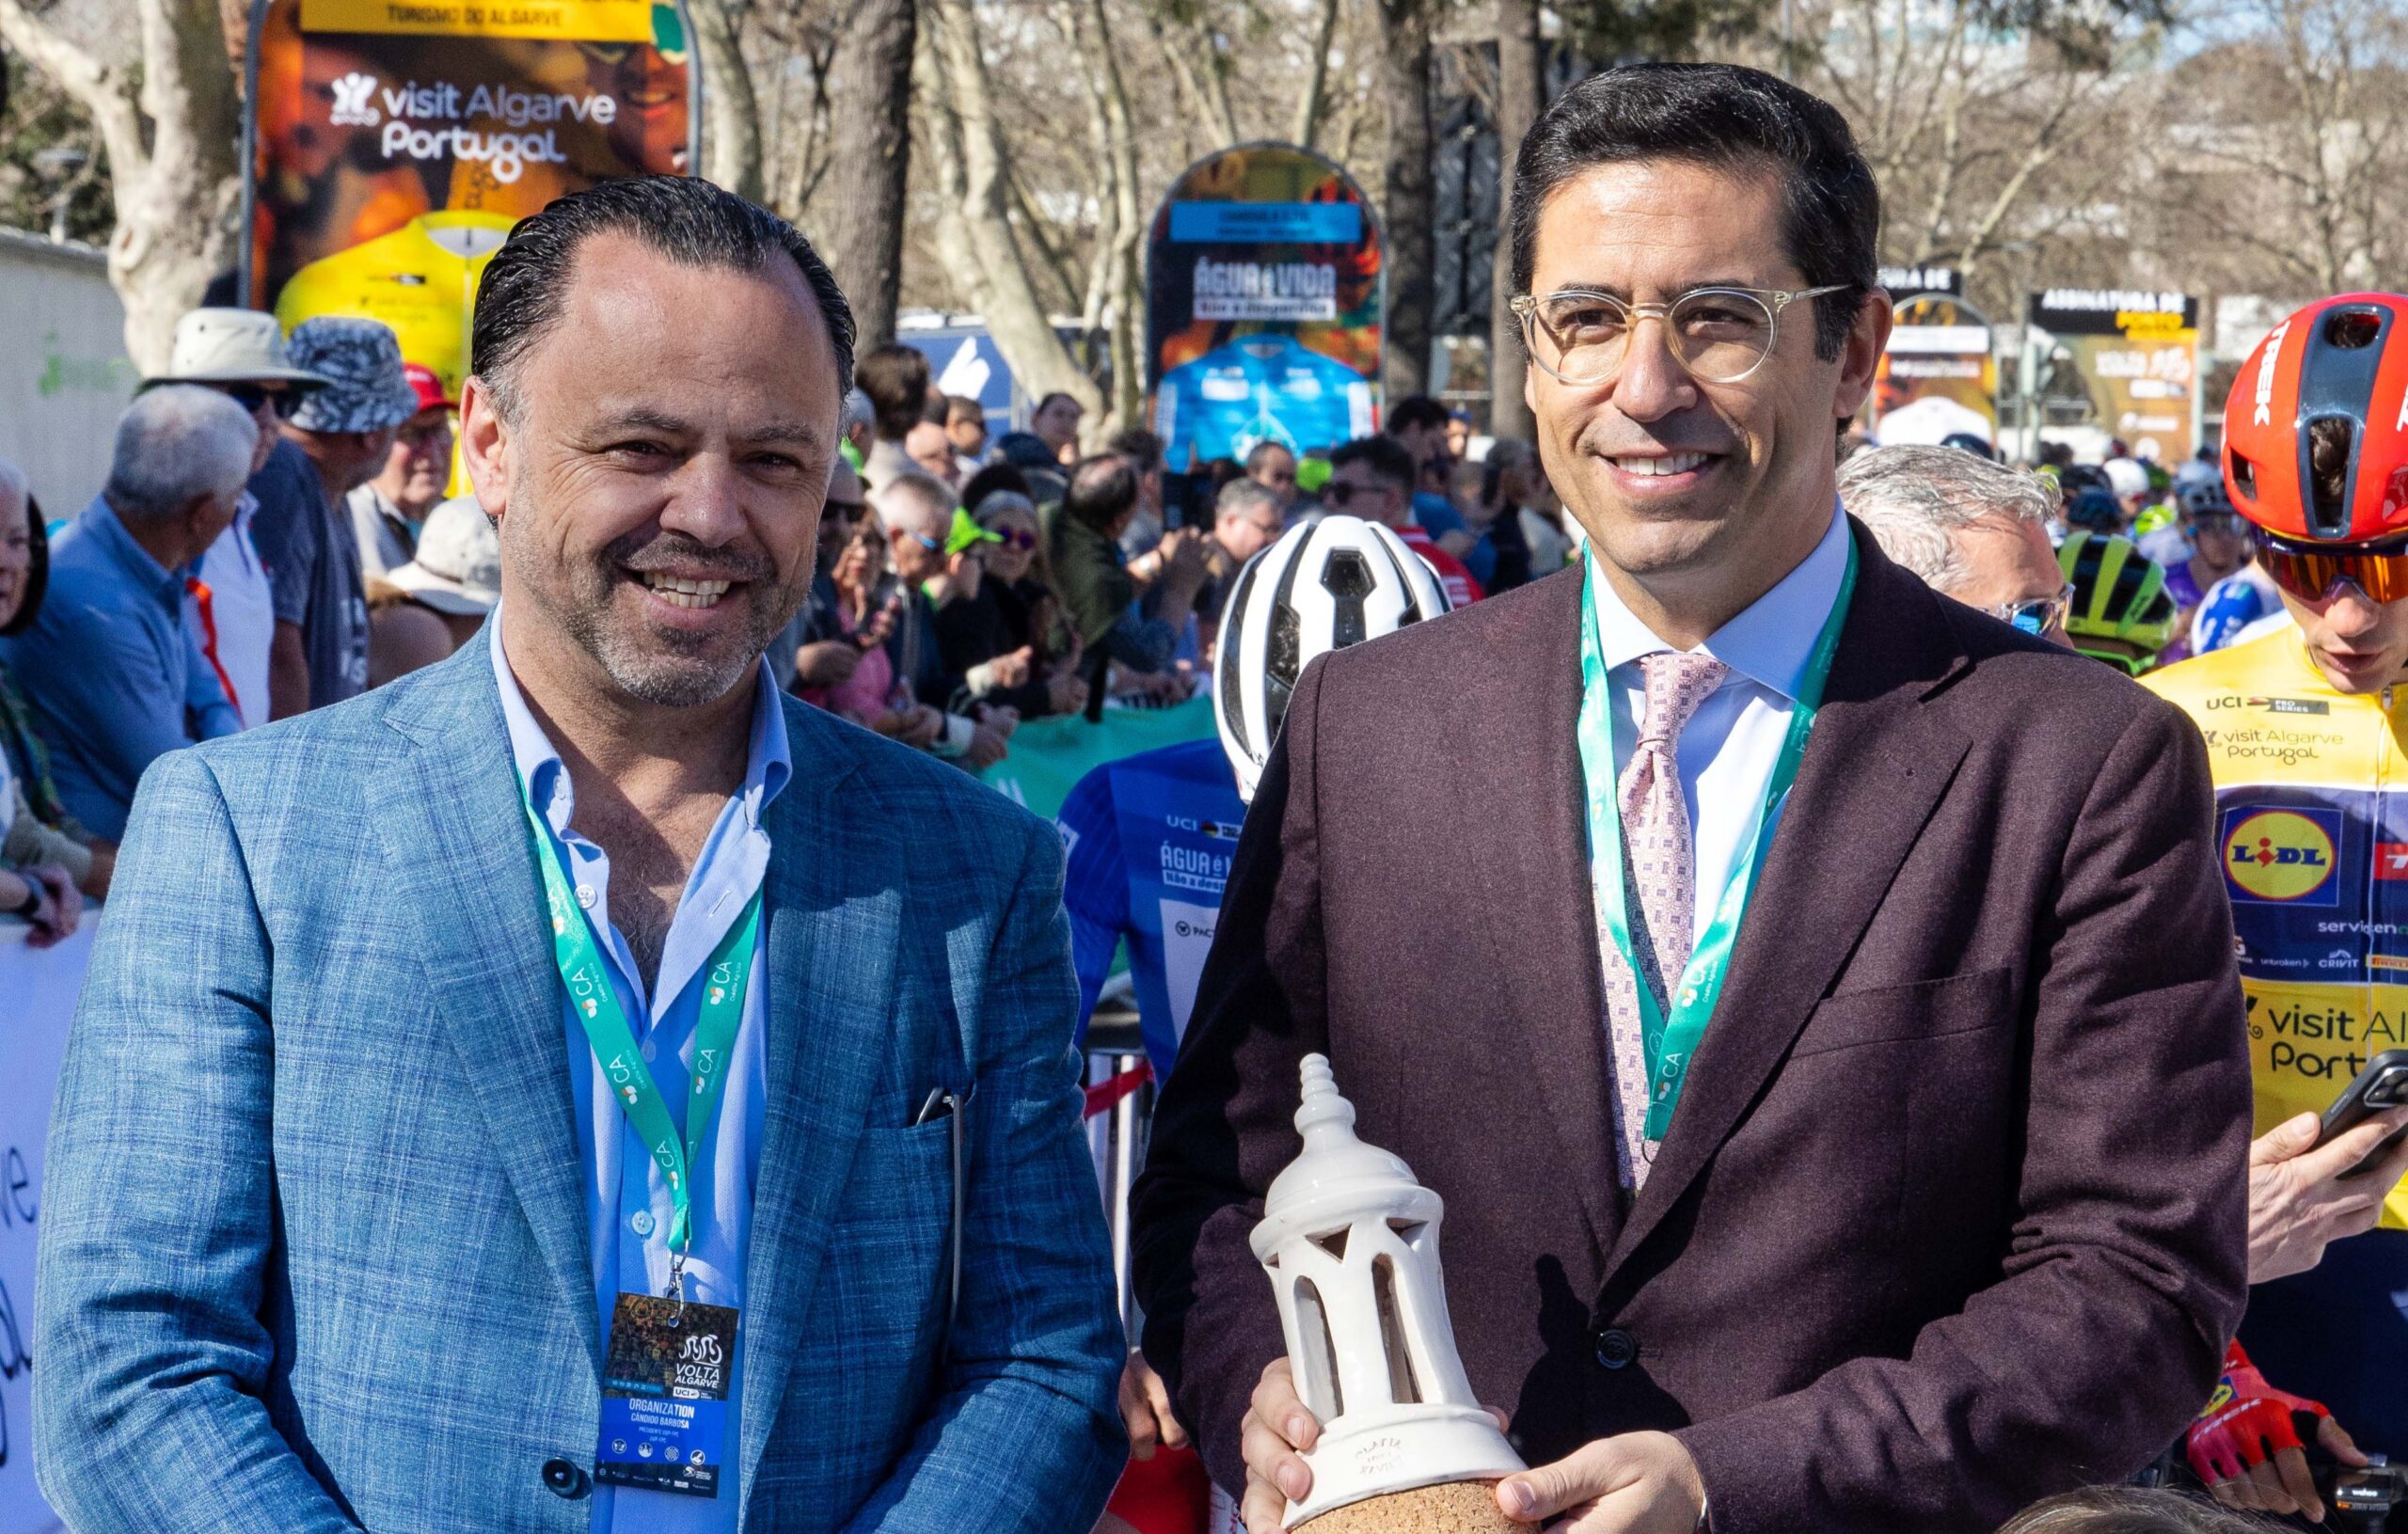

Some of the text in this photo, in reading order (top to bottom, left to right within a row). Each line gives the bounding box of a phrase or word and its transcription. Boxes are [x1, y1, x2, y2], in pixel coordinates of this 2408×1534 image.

[382, 80, 617, 128] visit Algarve
[381, 120, 568, 183] Portugal
[2254, 320, 2291, 427] TREK
[2206, 696, 2242, 710] UCI
[2224, 730, 2345, 745] visit Algarve
[2226, 745, 2320, 767] Portugal
[1166, 814, 1197, 831] UCI
[1160, 840, 1211, 876] ÁGUA
[712, 961, 733, 985] CA
[2318, 959, 2360, 969] CRIVIT
[572, 966, 594, 997] CA
[2268, 1004, 2355, 1042] visit
[609, 1053, 631, 1083] CA
[697, 1049, 717, 1074] CA
[1662, 1052, 1683, 1079] CA
[656, 1140, 674, 1168] CA
[674, 1375, 721, 1389] ALGARVE
[675, 1363, 721, 1381] VOLTA
[675, 1388, 690, 1397] UCI
[628, 1398, 695, 1419] ORGANIZATION
[659, 1416, 689, 1430] BARBOSA
